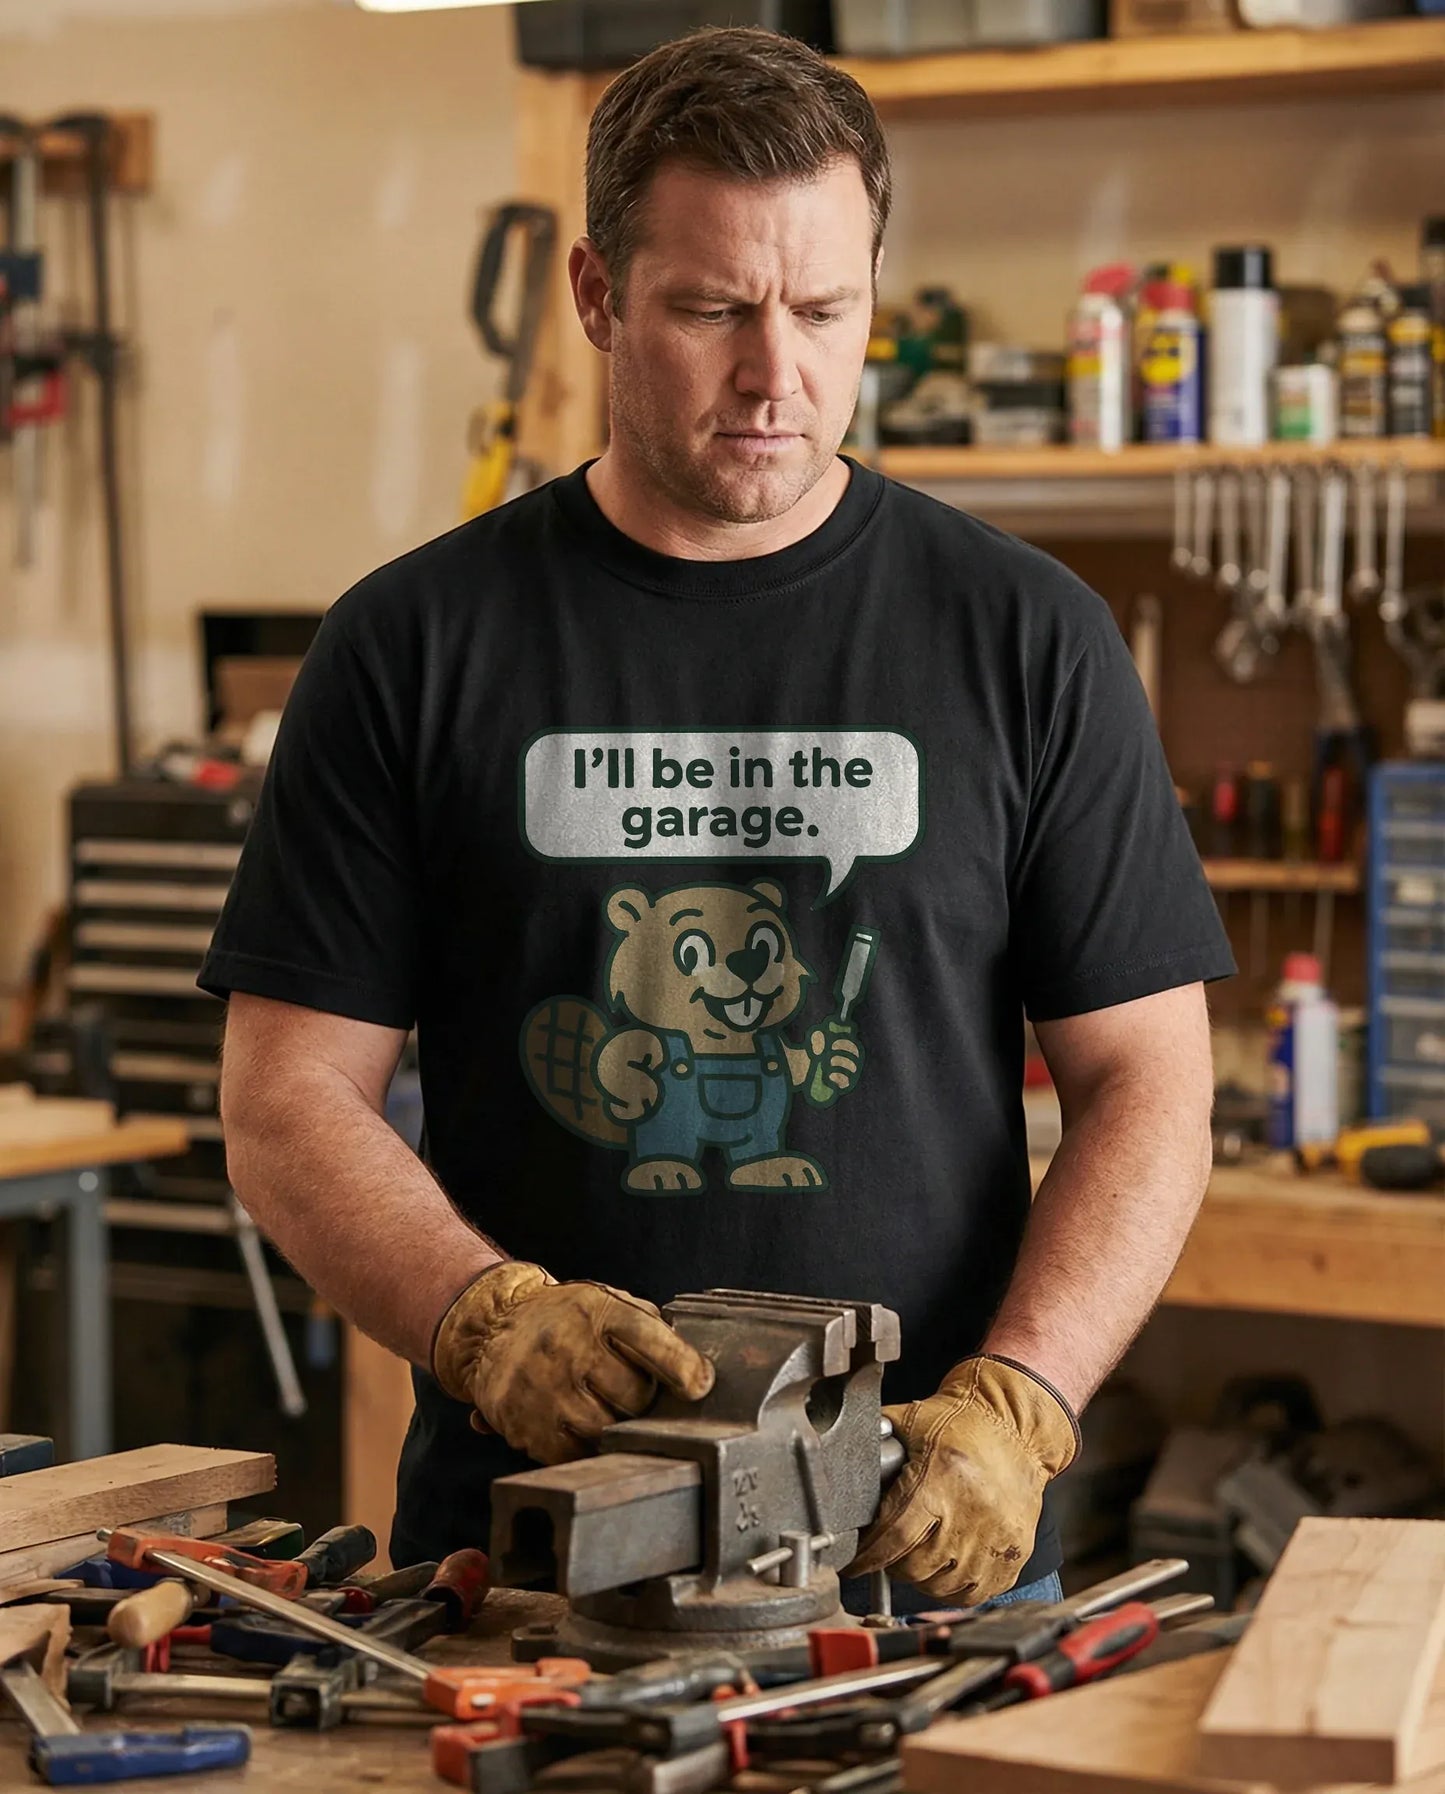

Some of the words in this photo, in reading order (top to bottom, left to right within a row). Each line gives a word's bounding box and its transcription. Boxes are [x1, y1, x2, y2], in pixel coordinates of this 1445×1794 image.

[574, 747, 635, 789] I’ll
[652, 747, 715, 789] be
[728, 745, 774, 789] in
[788, 746, 874, 789] the
[621, 805, 820, 850] garage.
